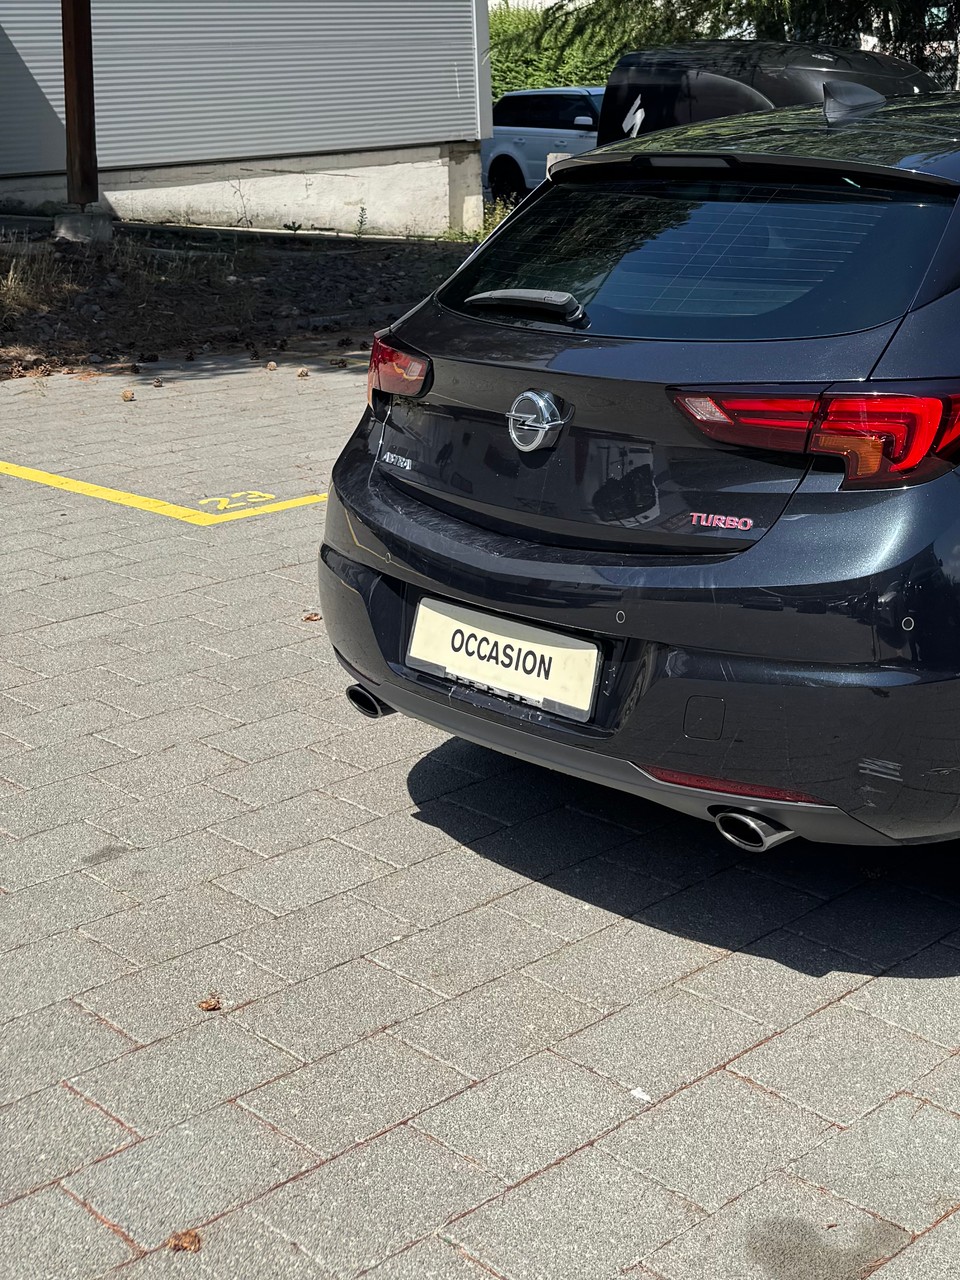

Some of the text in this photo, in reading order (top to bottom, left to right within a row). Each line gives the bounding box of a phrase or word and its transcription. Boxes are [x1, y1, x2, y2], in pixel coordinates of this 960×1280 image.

[198, 490, 276, 510] 23
[689, 512, 753, 531] TURBO
[450, 628, 553, 681] OCCASION
